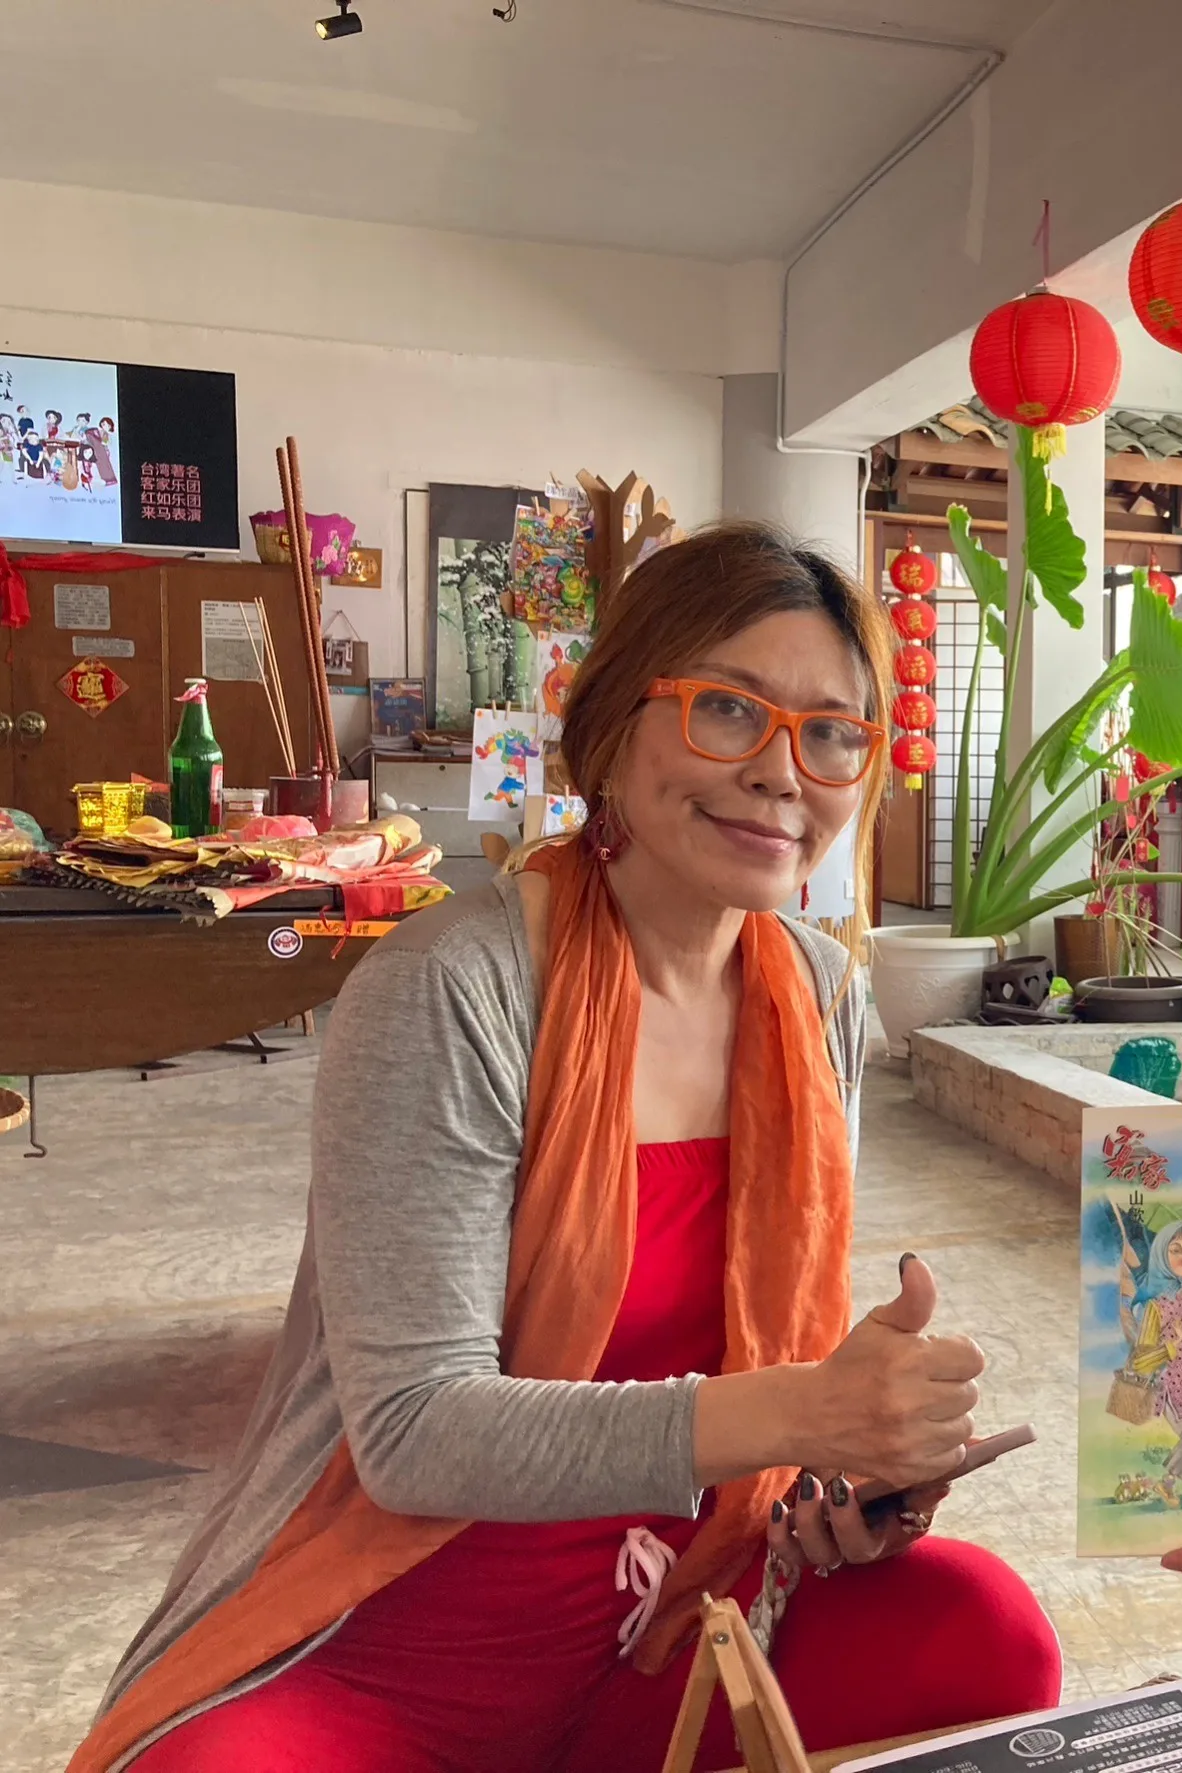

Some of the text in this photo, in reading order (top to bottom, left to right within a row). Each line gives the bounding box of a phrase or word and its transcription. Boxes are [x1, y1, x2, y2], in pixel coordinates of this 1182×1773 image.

[140, 462, 200, 479] 台湾著名
[140, 477, 201, 493] 客家乐团
[140, 491, 201, 508] 红如乐团
[141, 506, 202, 522] 来马表演
